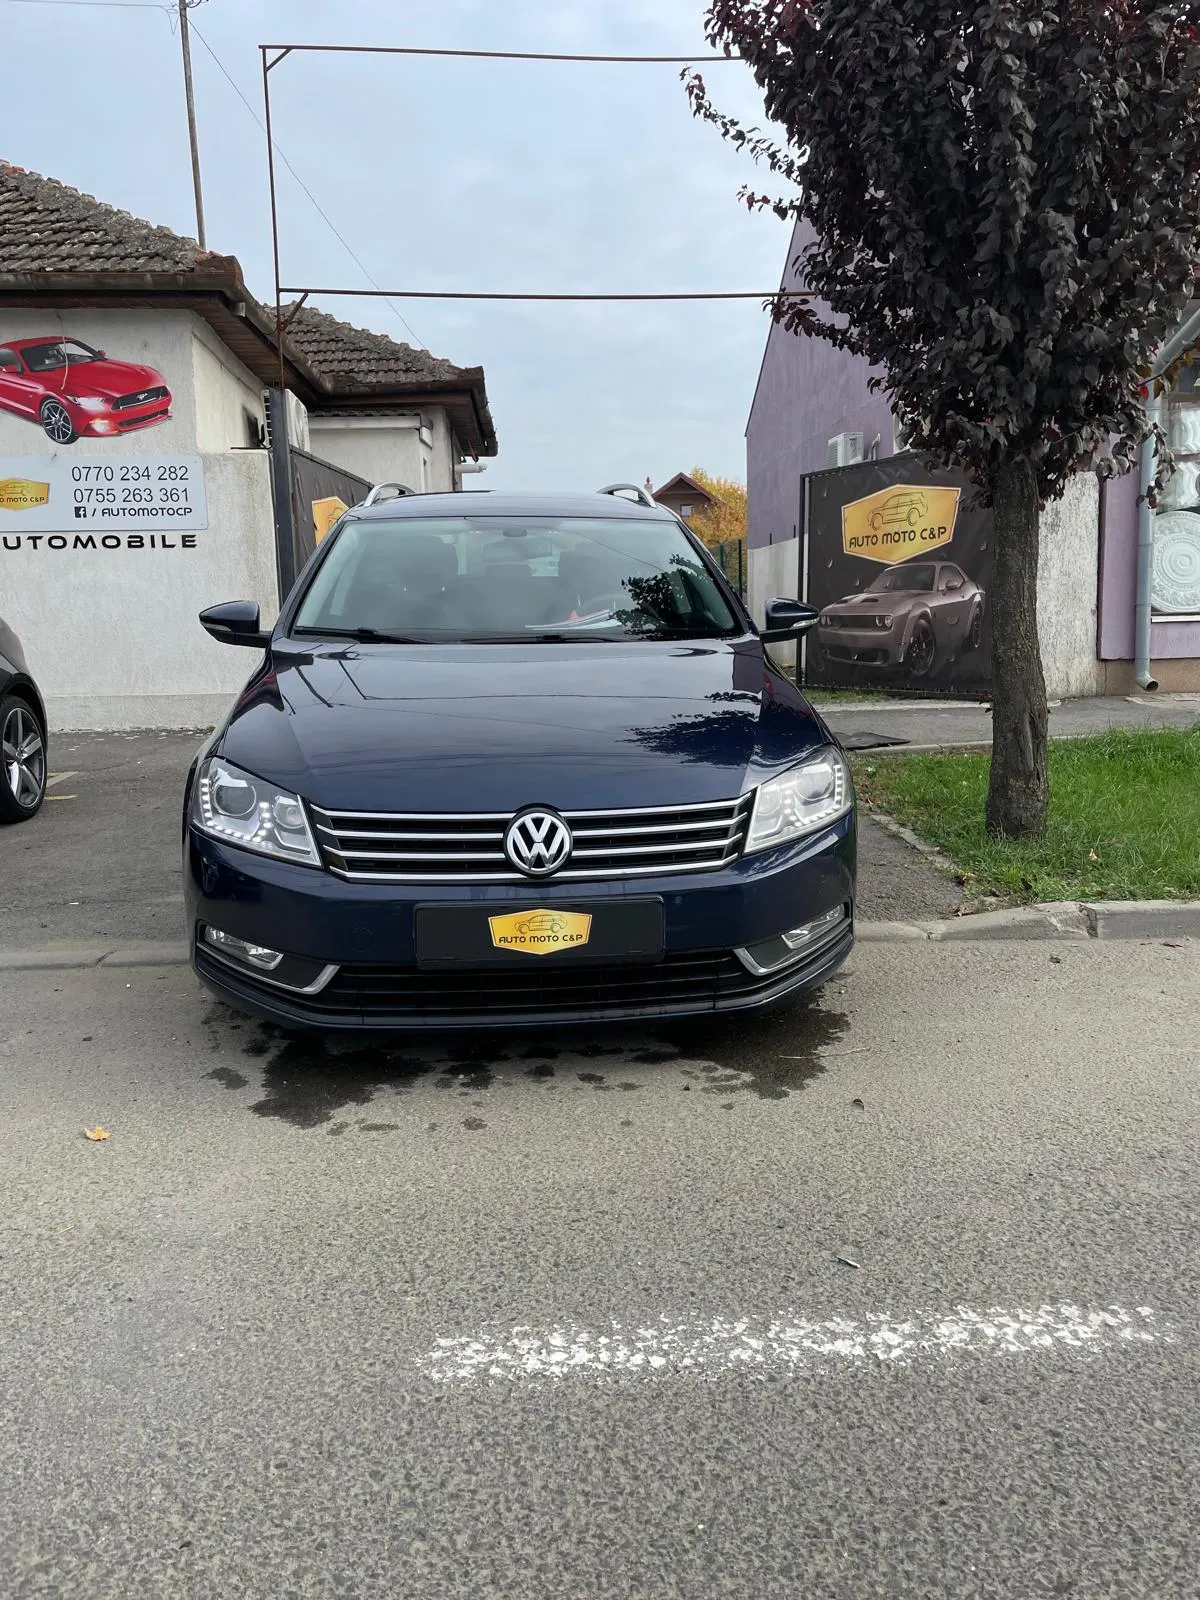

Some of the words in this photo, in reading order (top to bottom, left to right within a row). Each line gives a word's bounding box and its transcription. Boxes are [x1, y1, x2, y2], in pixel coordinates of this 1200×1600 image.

[71, 466, 114, 481] 0770
[119, 466, 151, 481] 234
[157, 465, 189, 481] 282
[73, 488, 116, 503] 0755
[122, 488, 153, 503] 263
[159, 487, 189, 502] 361
[101, 507, 192, 517] AUTOMOTOCP
[849, 534, 878, 549] AUTO
[881, 529, 916, 545] MOTO
[920, 526, 947, 541] C&P
[507, 812, 570, 874] VW
[499, 936, 526, 944] AUTO
[529, 935, 559, 943] MOTO
[562, 934, 583, 942] C&P
